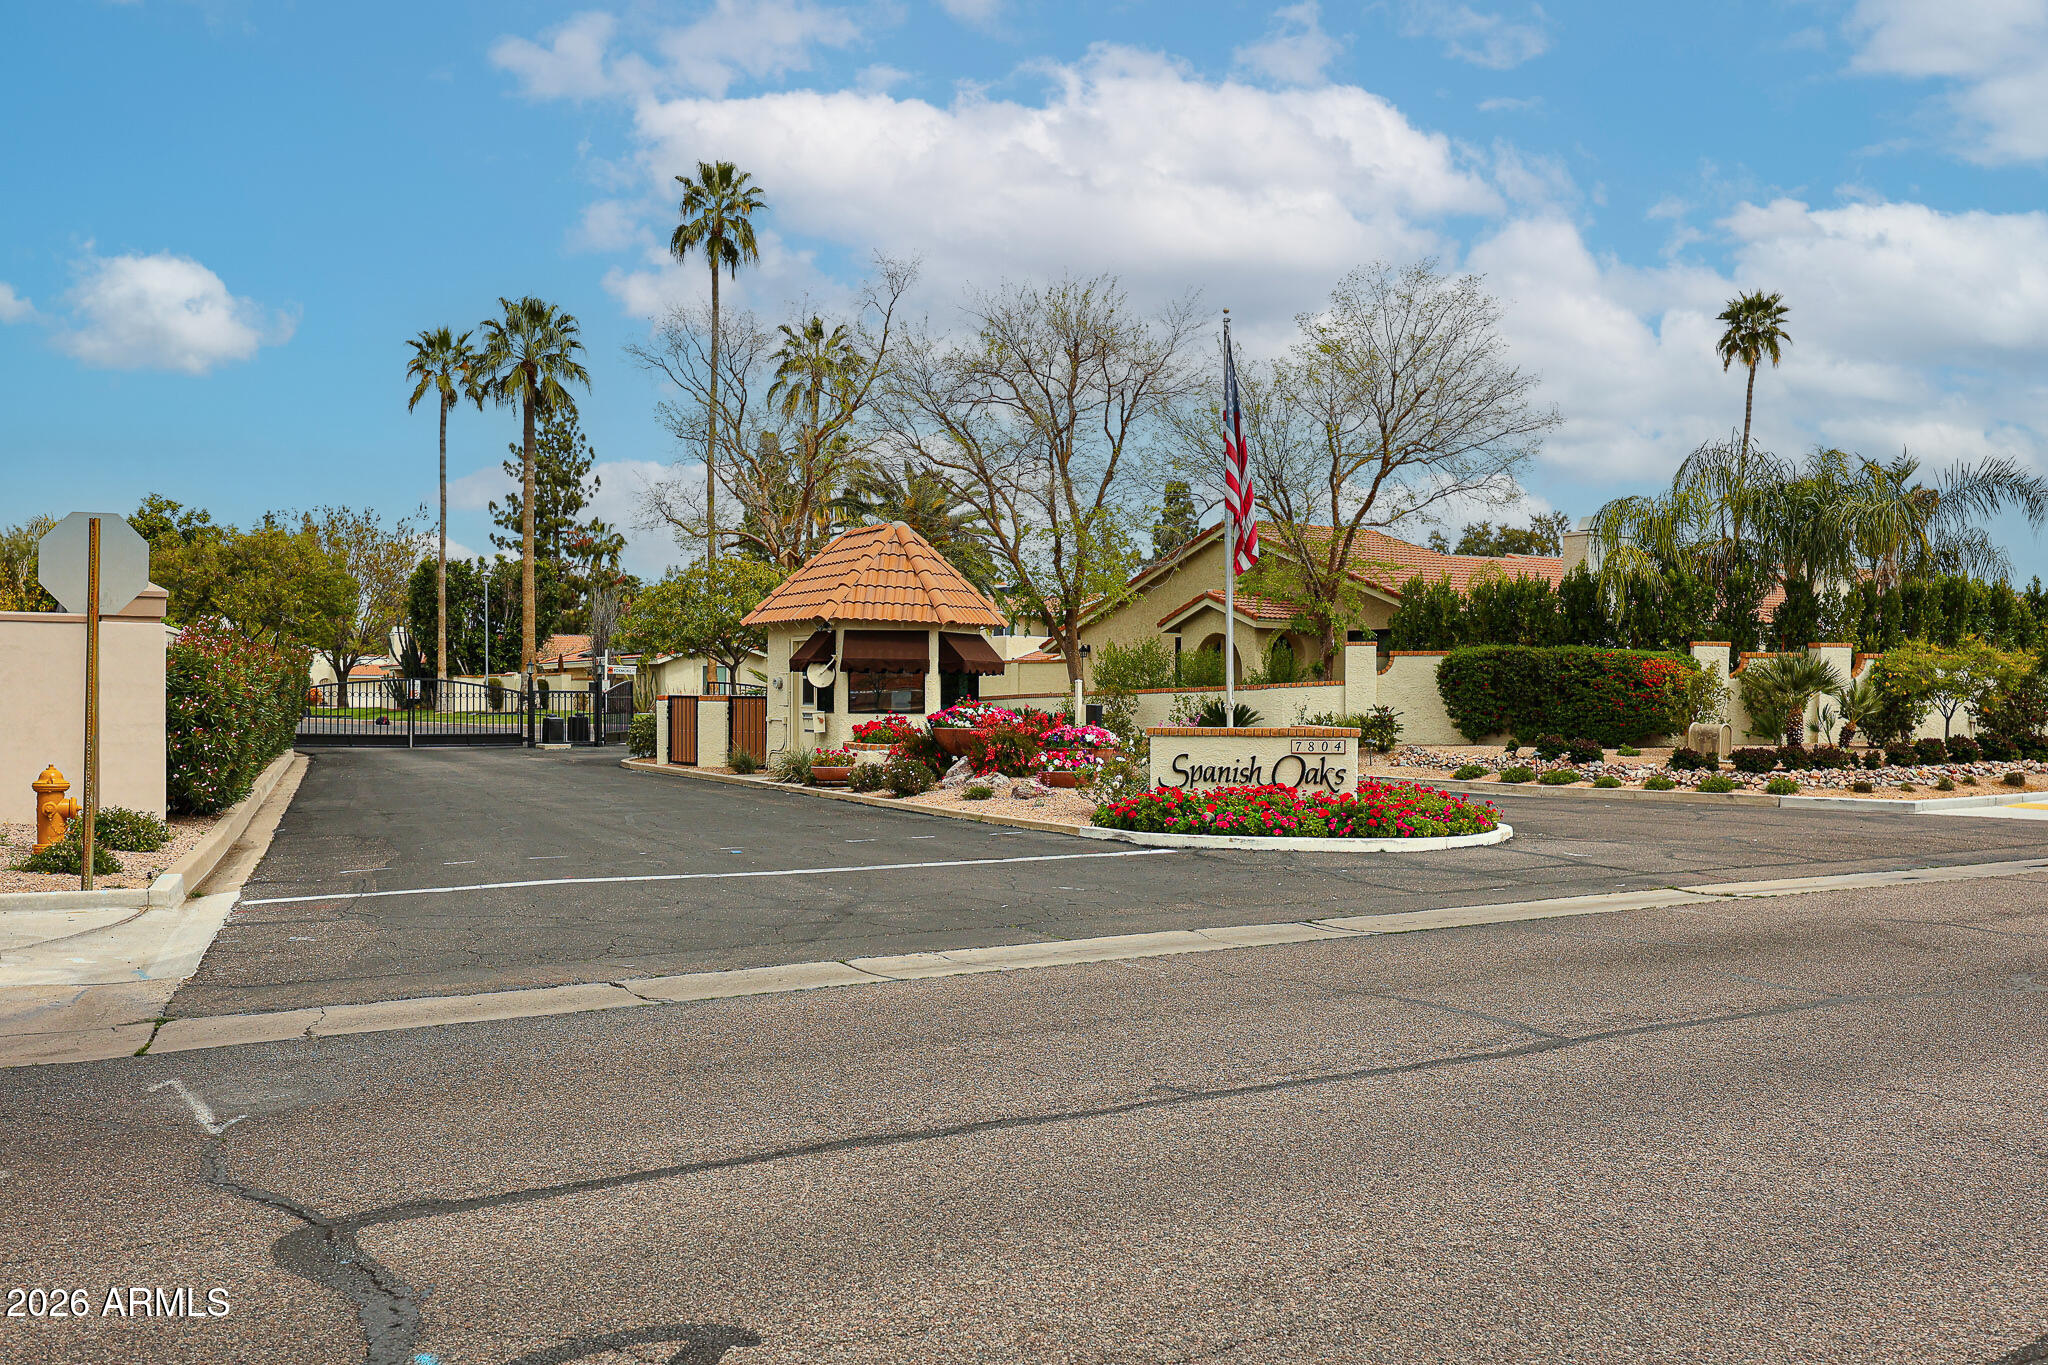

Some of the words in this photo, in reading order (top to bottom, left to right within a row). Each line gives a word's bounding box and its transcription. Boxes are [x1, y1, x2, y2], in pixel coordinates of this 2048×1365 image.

[1295, 741, 1342, 752] 7804
[1158, 753, 1271, 789] Spanish
[1271, 754, 1347, 793] Oaks
